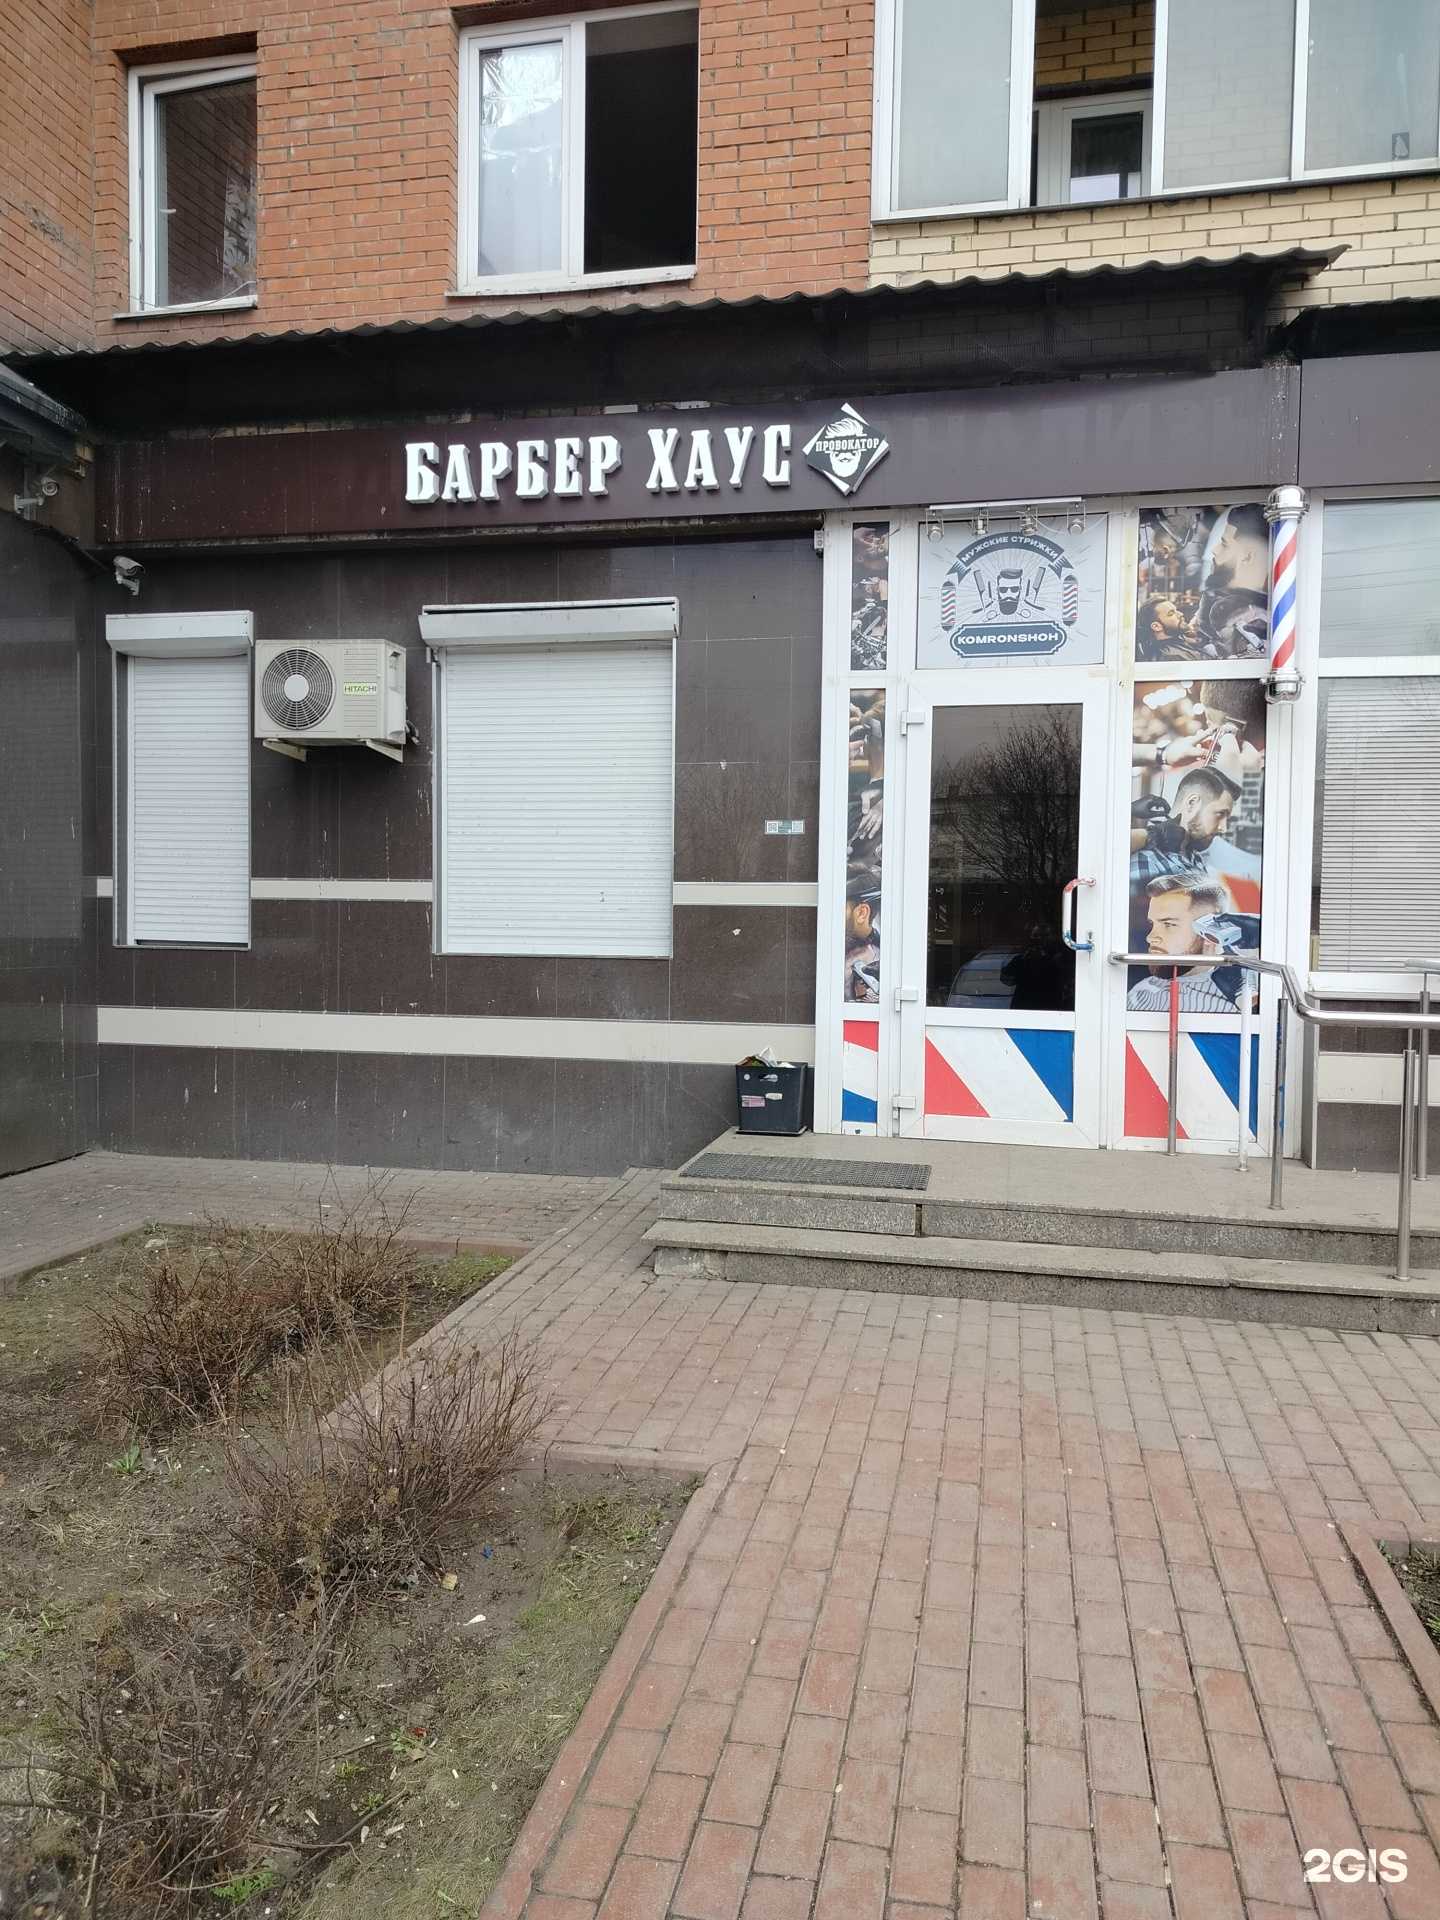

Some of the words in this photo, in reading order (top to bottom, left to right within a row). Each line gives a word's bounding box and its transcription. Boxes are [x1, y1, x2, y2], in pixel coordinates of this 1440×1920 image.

[815, 438, 880, 452] ПРОВОКАТОР
[405, 435, 622, 504] БАРБЕР
[645, 424, 792, 493] ХАУС
[961, 536, 1009, 563] МУЖСКИЕ
[1010, 535, 1059, 560] СТРИЖКИ
[957, 632, 1059, 645] KOMRONSHOH
